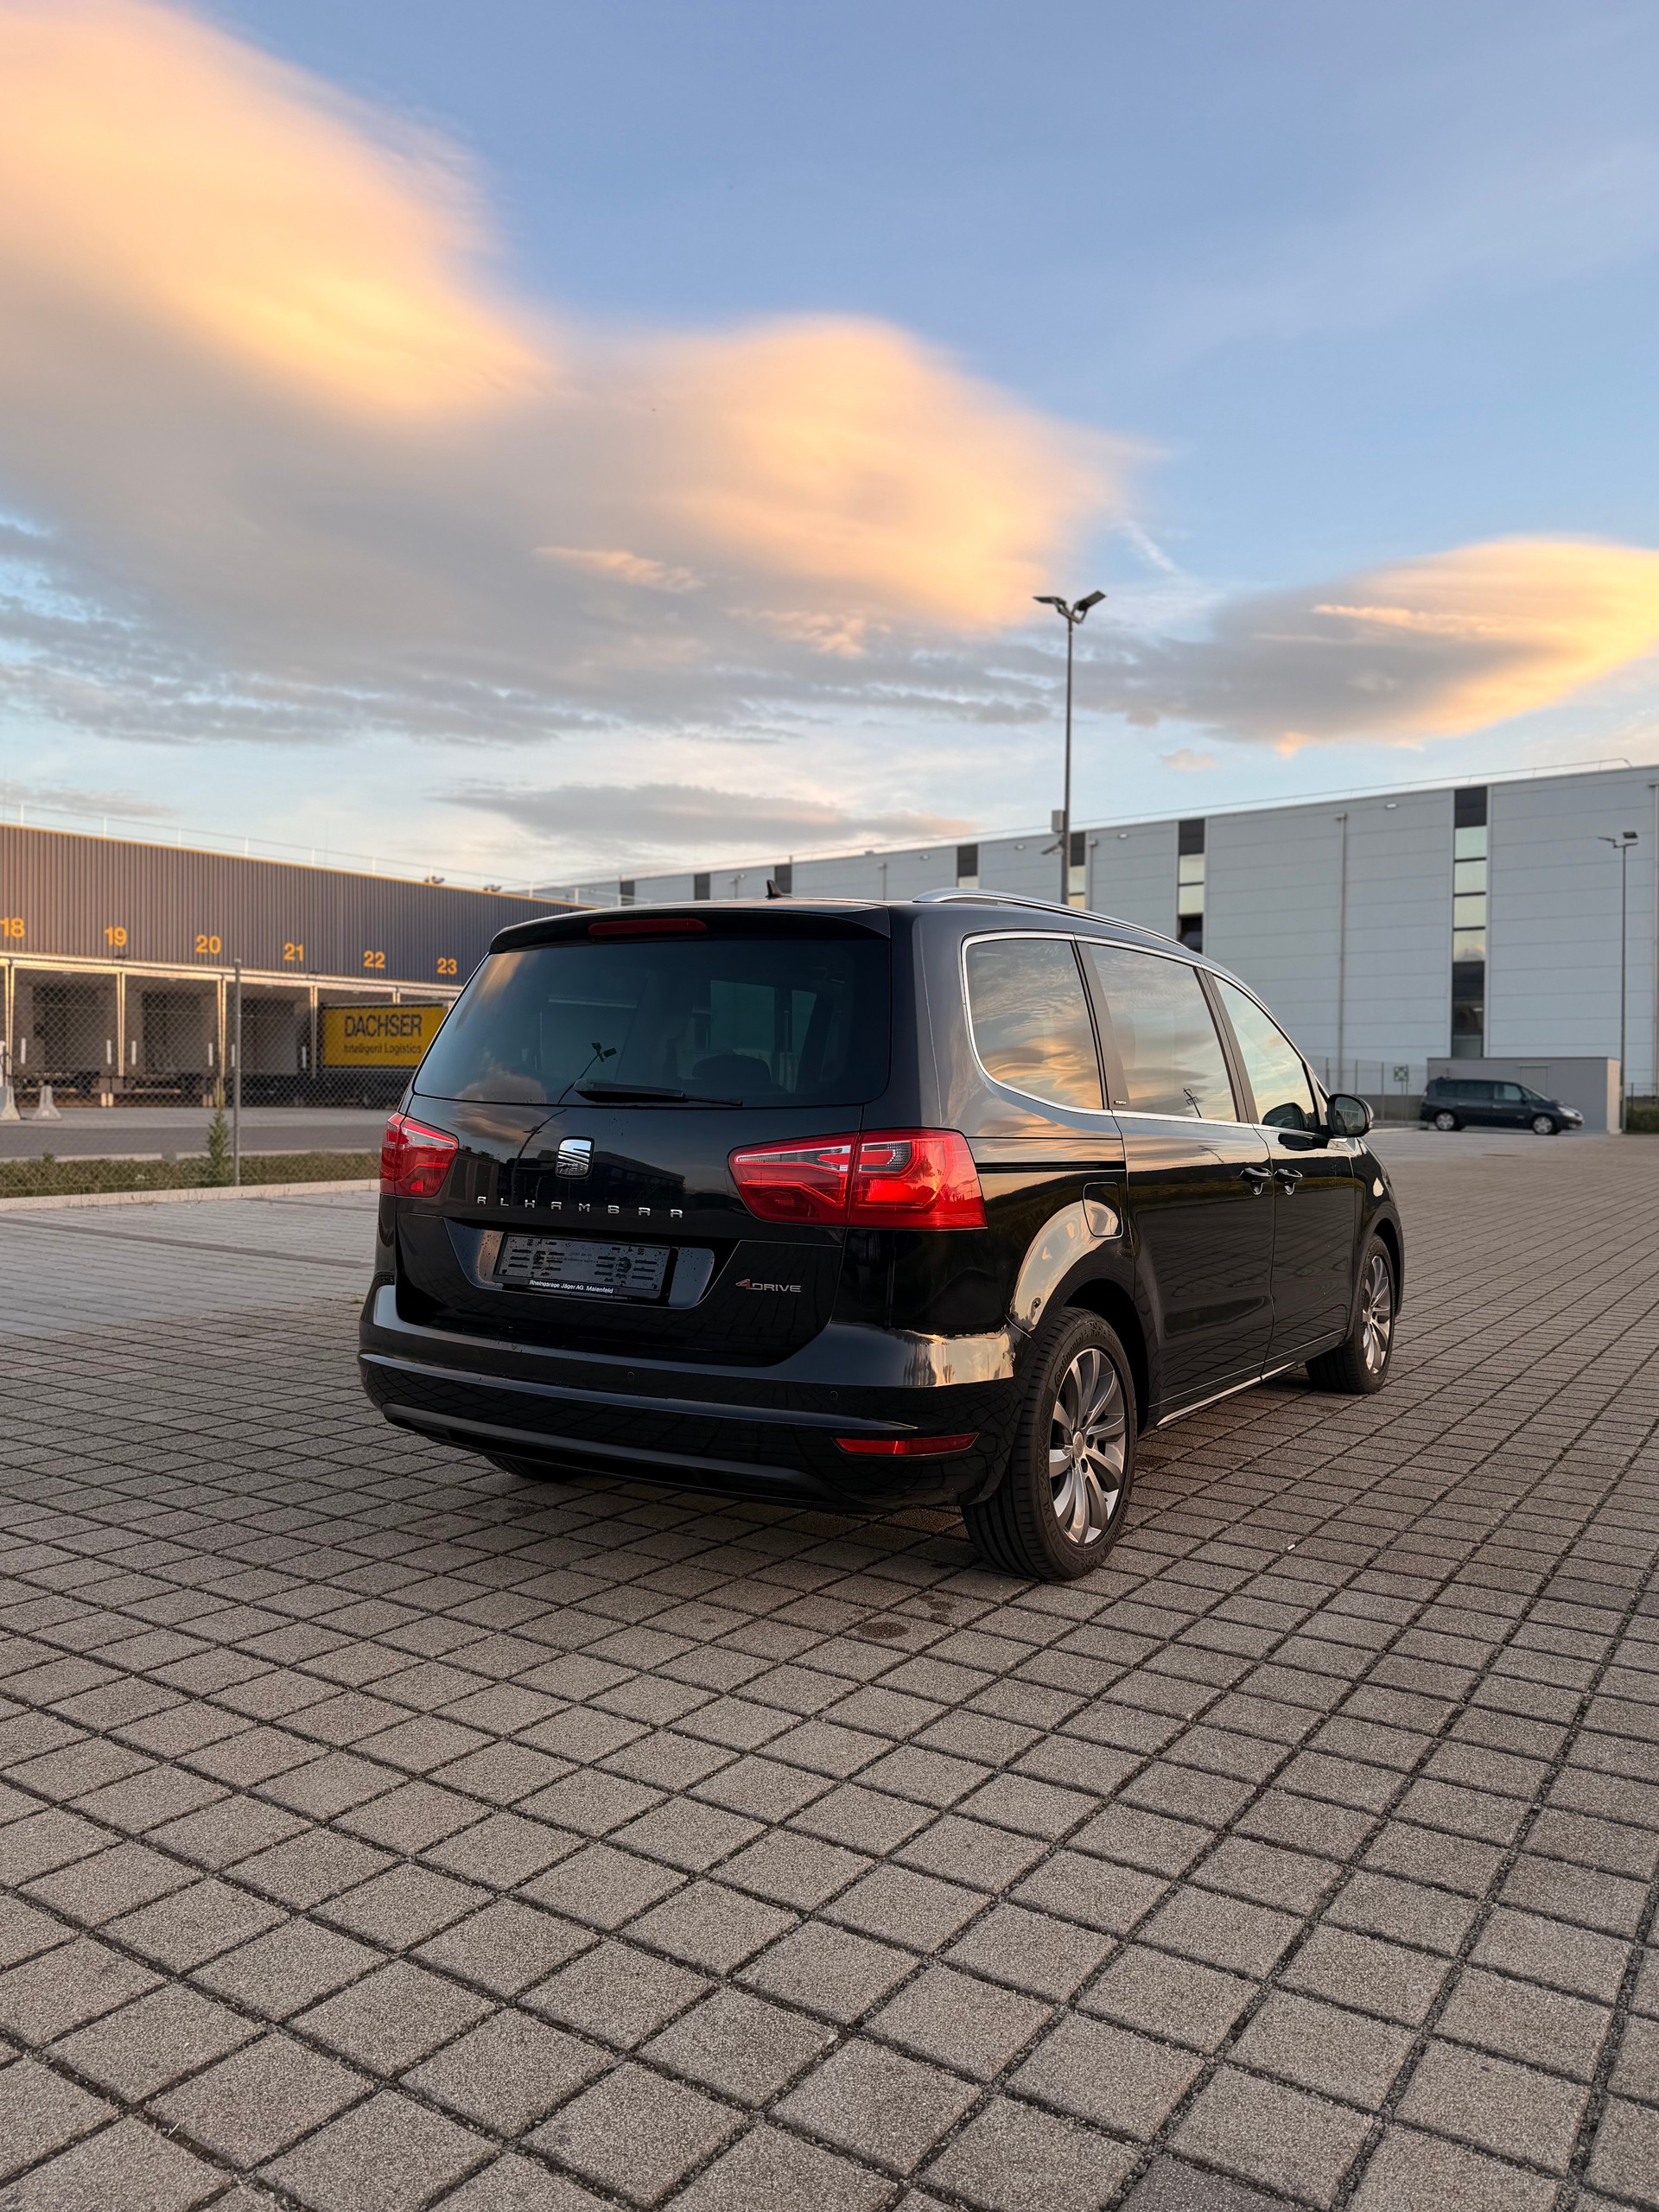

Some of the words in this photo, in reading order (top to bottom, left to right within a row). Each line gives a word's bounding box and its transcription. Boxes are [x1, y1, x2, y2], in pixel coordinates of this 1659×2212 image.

[0, 918, 25, 938] 18
[104, 926, 127, 947] 19
[195, 934, 221, 954] 20
[283, 942, 303, 962] 21
[363, 950, 385, 969] 22
[436, 958, 457, 975] 23
[345, 1014, 422, 1037] DACHSER
[385, 1043, 422, 1055] Logistics
[477, 1196, 683, 1218] ALHAMBRA
[1055, 1331, 1084, 1389] Continental
